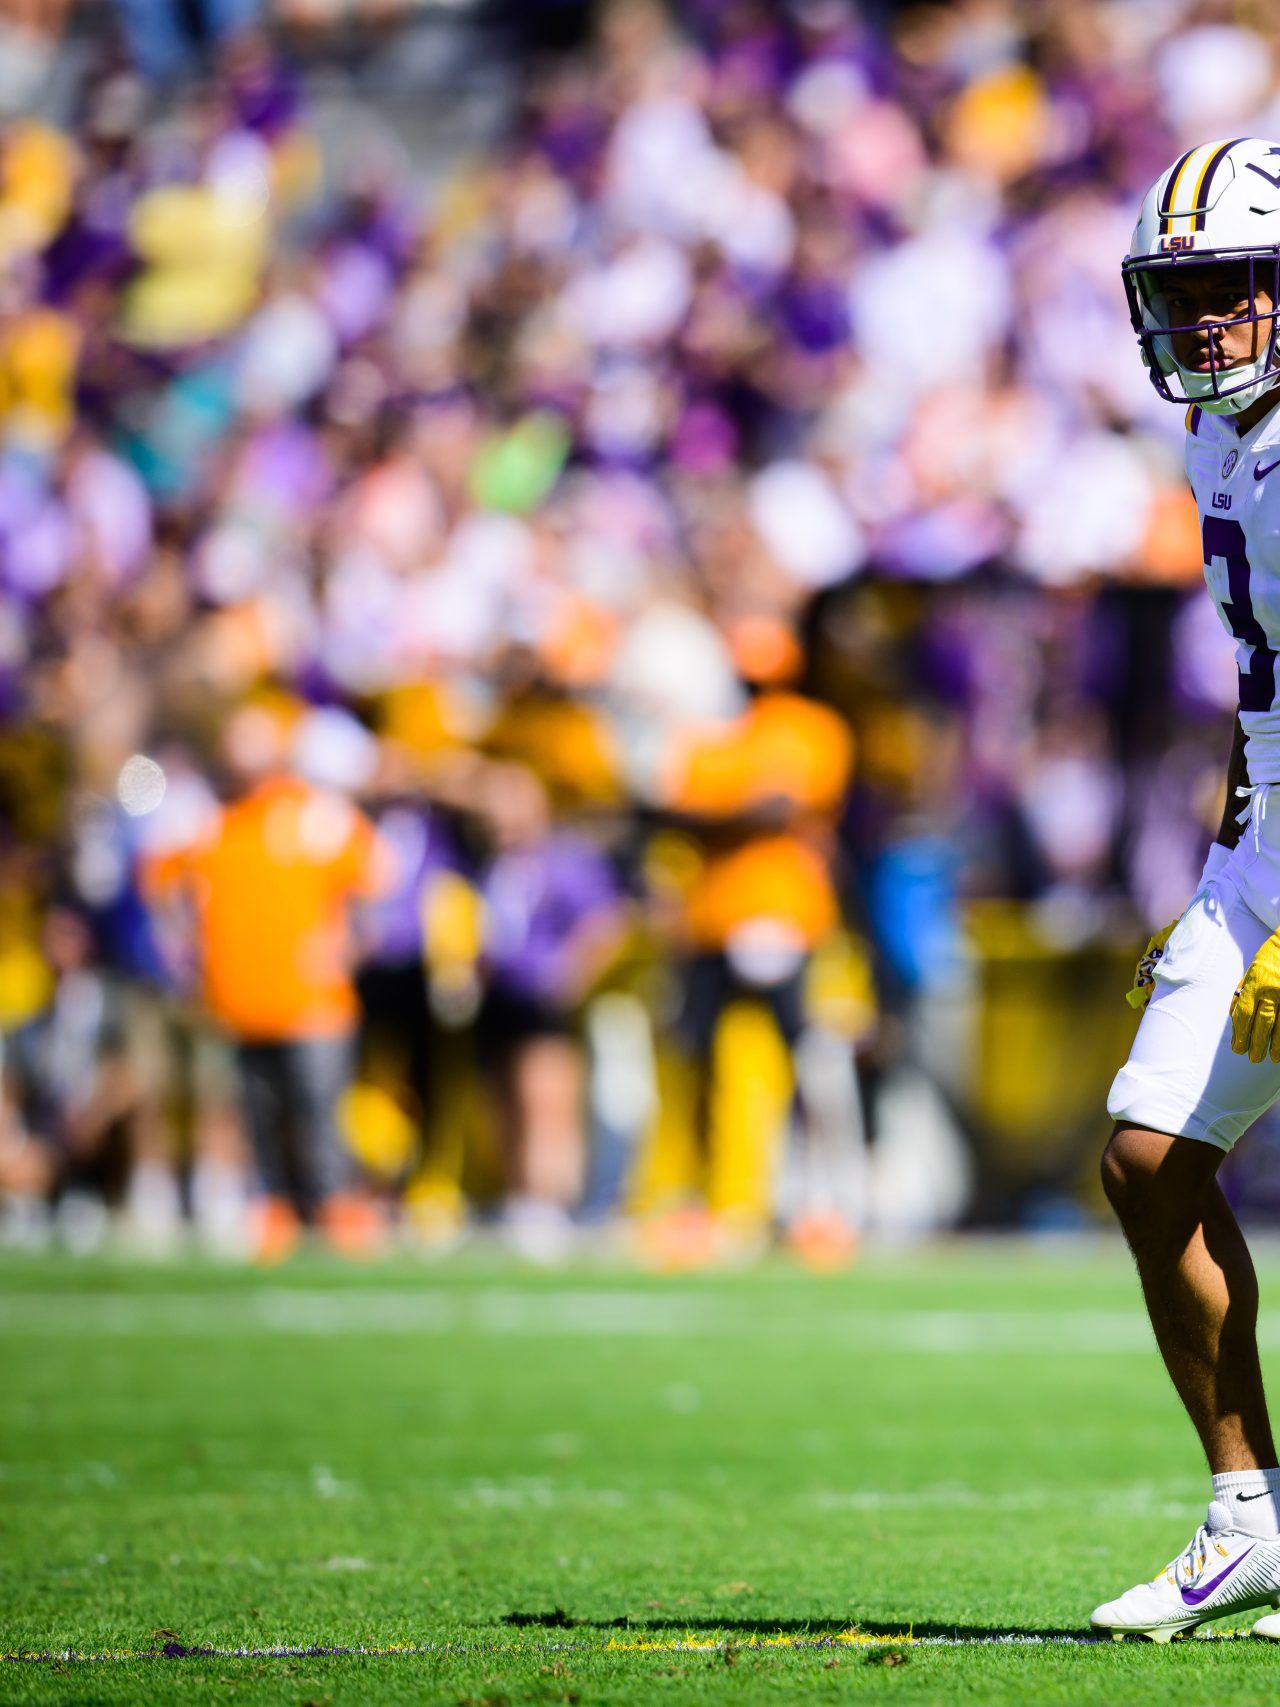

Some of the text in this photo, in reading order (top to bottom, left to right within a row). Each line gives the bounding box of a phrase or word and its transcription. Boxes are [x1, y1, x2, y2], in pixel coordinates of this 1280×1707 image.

[1161, 236, 1195, 251] LSU
[1212, 491, 1232, 510] LSU
[1203, 515, 1279, 712] 3
